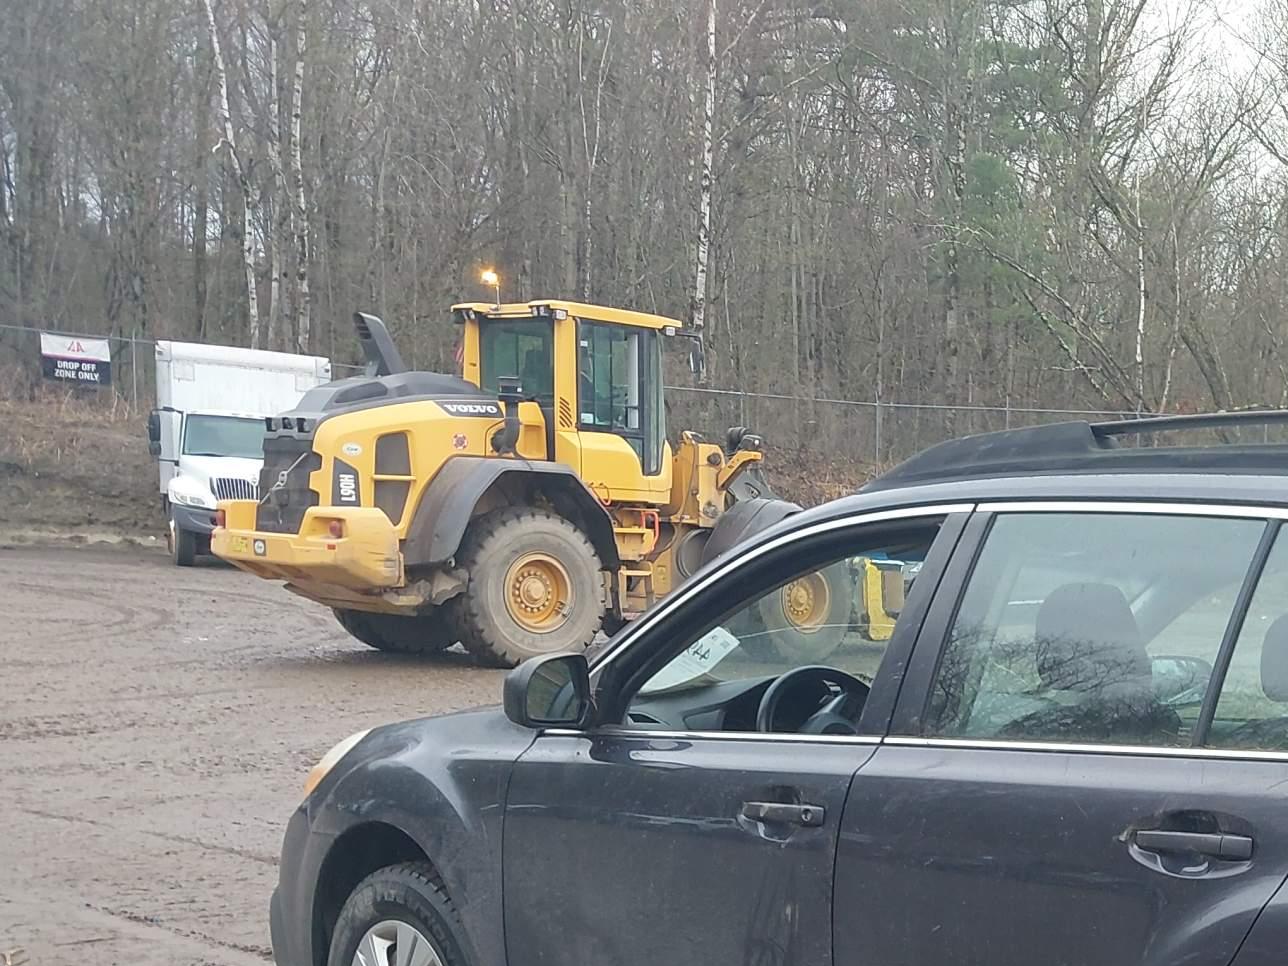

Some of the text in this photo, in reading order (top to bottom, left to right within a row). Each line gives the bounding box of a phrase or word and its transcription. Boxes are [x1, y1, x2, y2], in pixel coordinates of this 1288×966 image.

[57, 361, 96, 372] DROP OFF
[54, 369, 99, 381] ZONE ONLY
[443, 404, 498, 414] VOLVO
[339, 474, 356, 502] L90H
